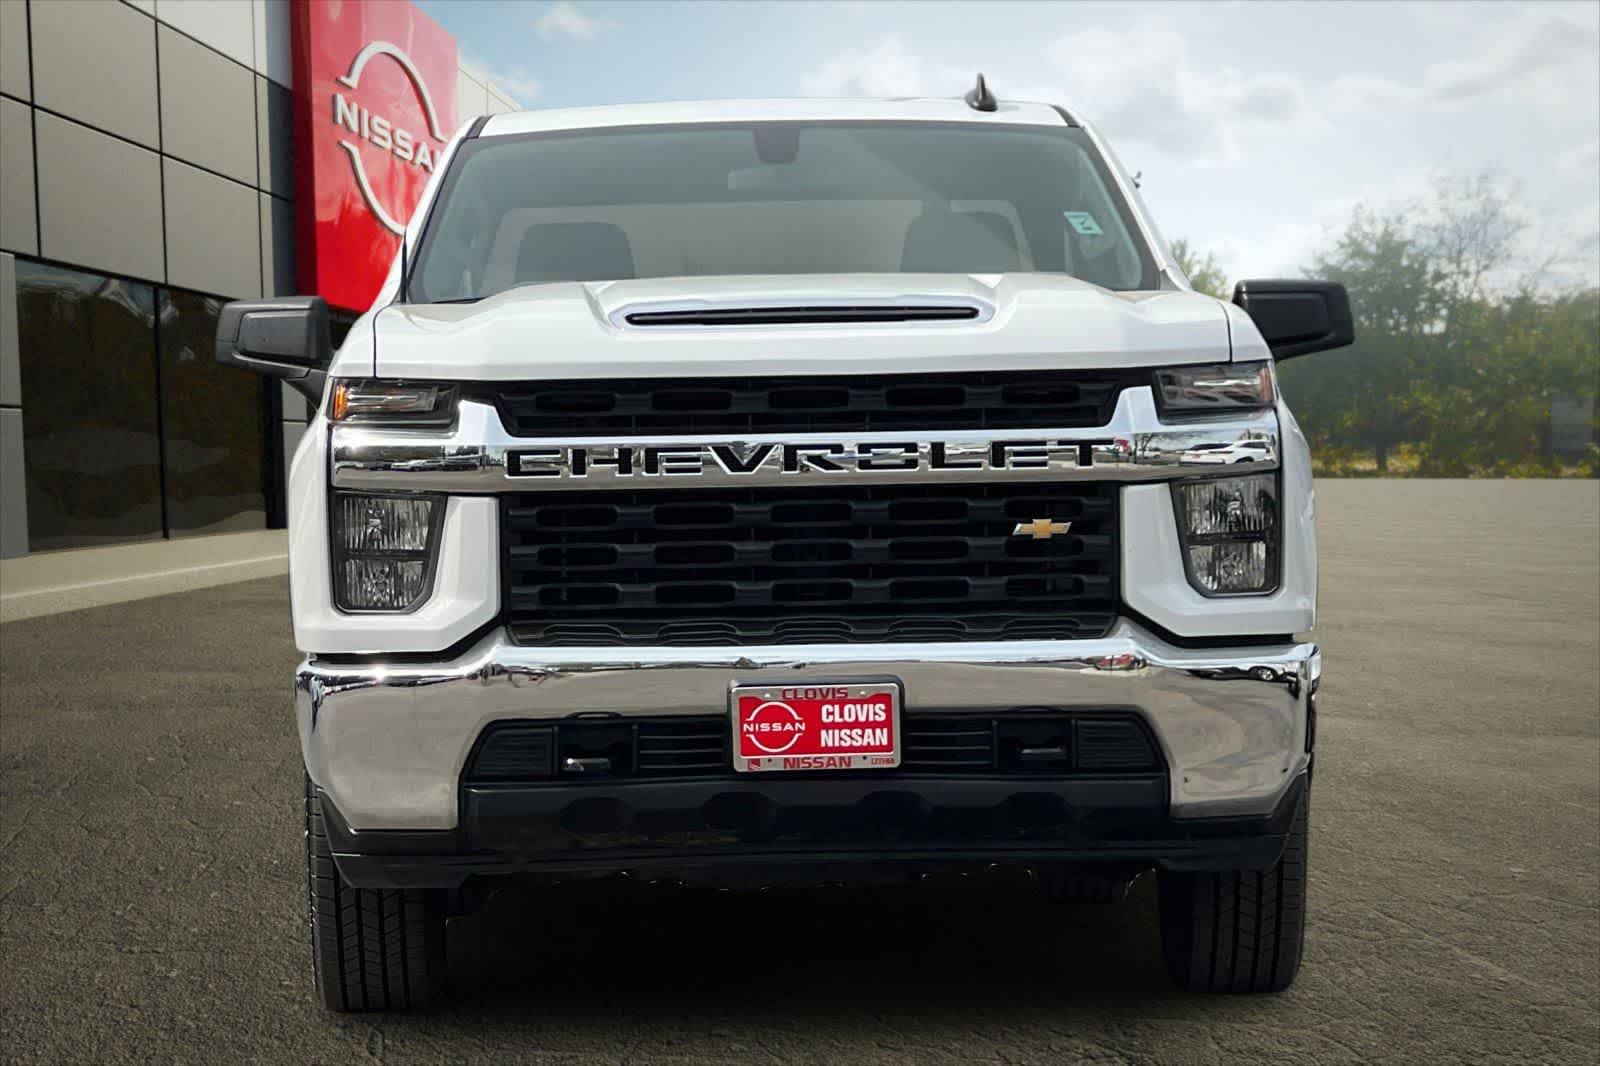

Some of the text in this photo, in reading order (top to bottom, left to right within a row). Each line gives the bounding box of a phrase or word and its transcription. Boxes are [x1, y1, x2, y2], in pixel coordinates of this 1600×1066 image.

[505, 439, 1115, 478] CHEVROLET
[781, 687, 849, 700] CLOVIS
[821, 703, 886, 724] CLOVIS
[743, 722, 806, 732] NISSAN
[820, 728, 888, 748] NISSAN
[783, 756, 852, 770] NISSAN
